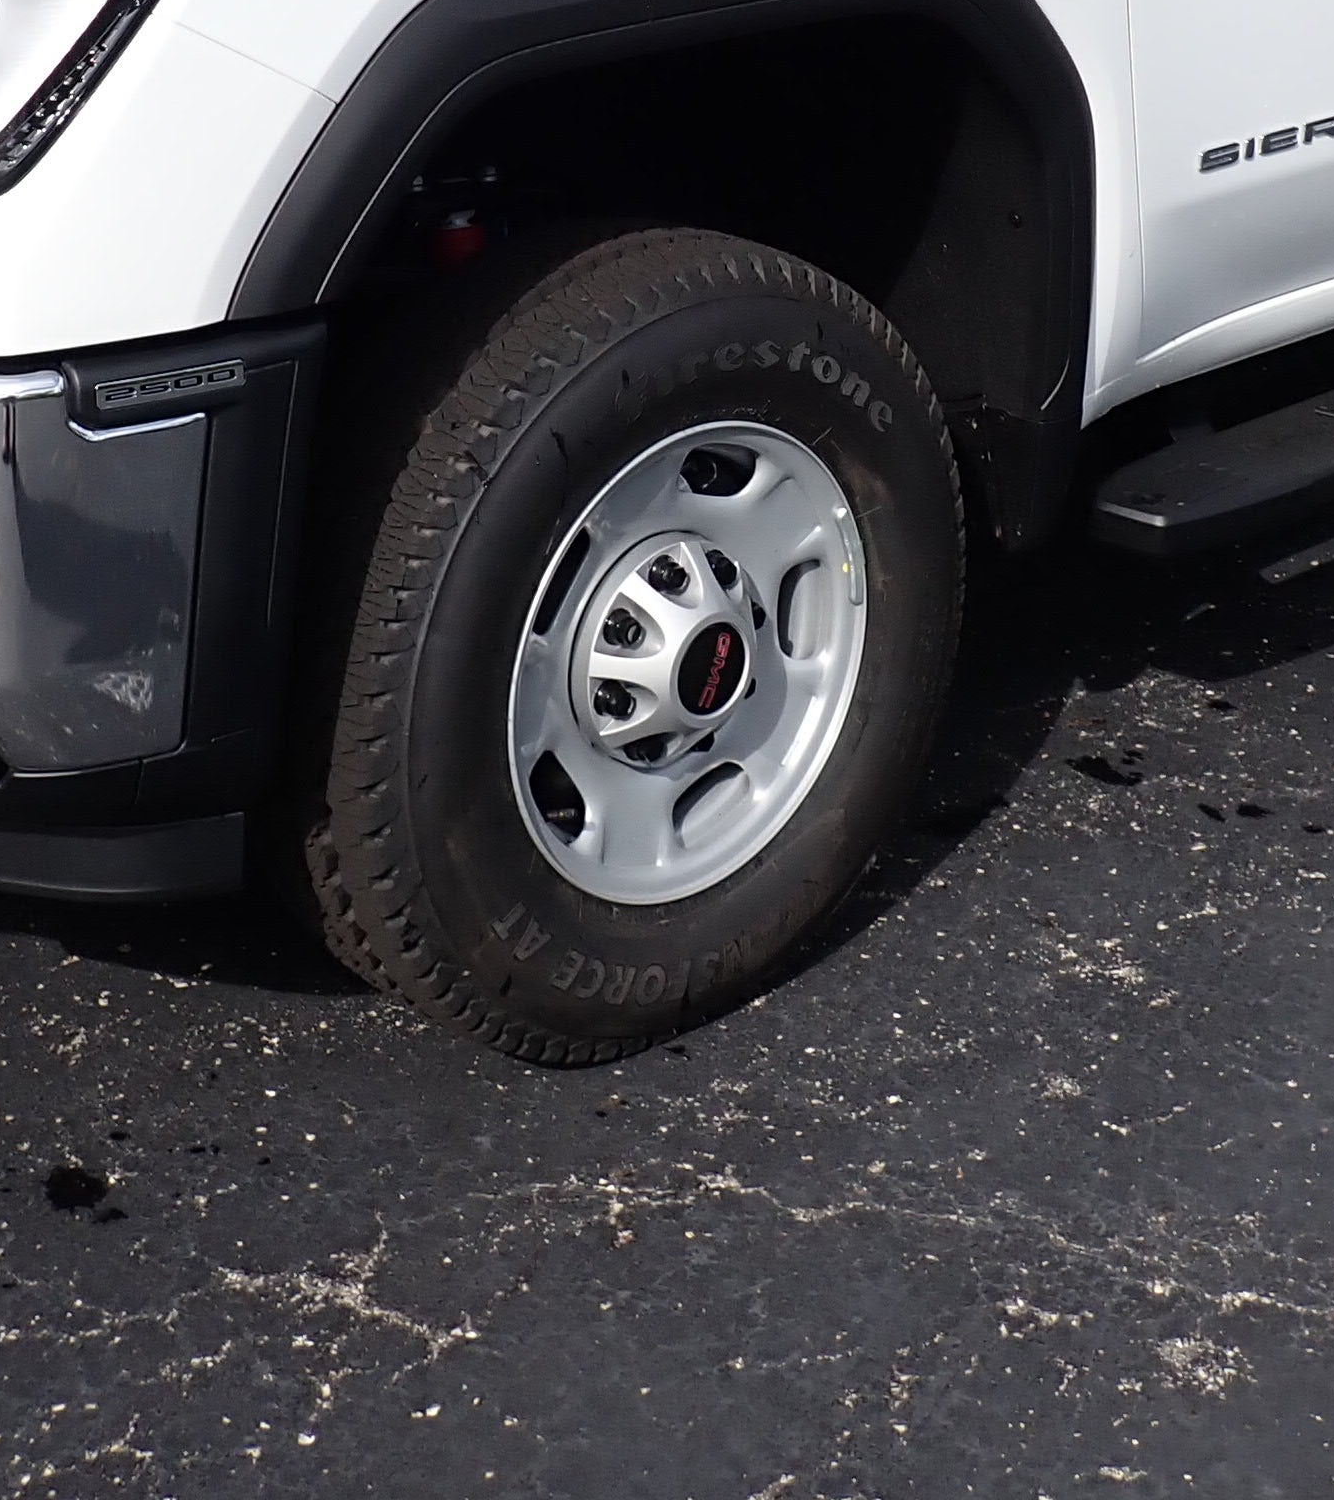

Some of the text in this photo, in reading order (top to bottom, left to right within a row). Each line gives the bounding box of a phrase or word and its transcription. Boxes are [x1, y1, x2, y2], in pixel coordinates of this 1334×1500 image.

[105, 368, 237, 402] 2500
[615, 339, 893, 433] restone
[698, 632, 731, 709] GMC
[489, 900, 552, 962] AT
